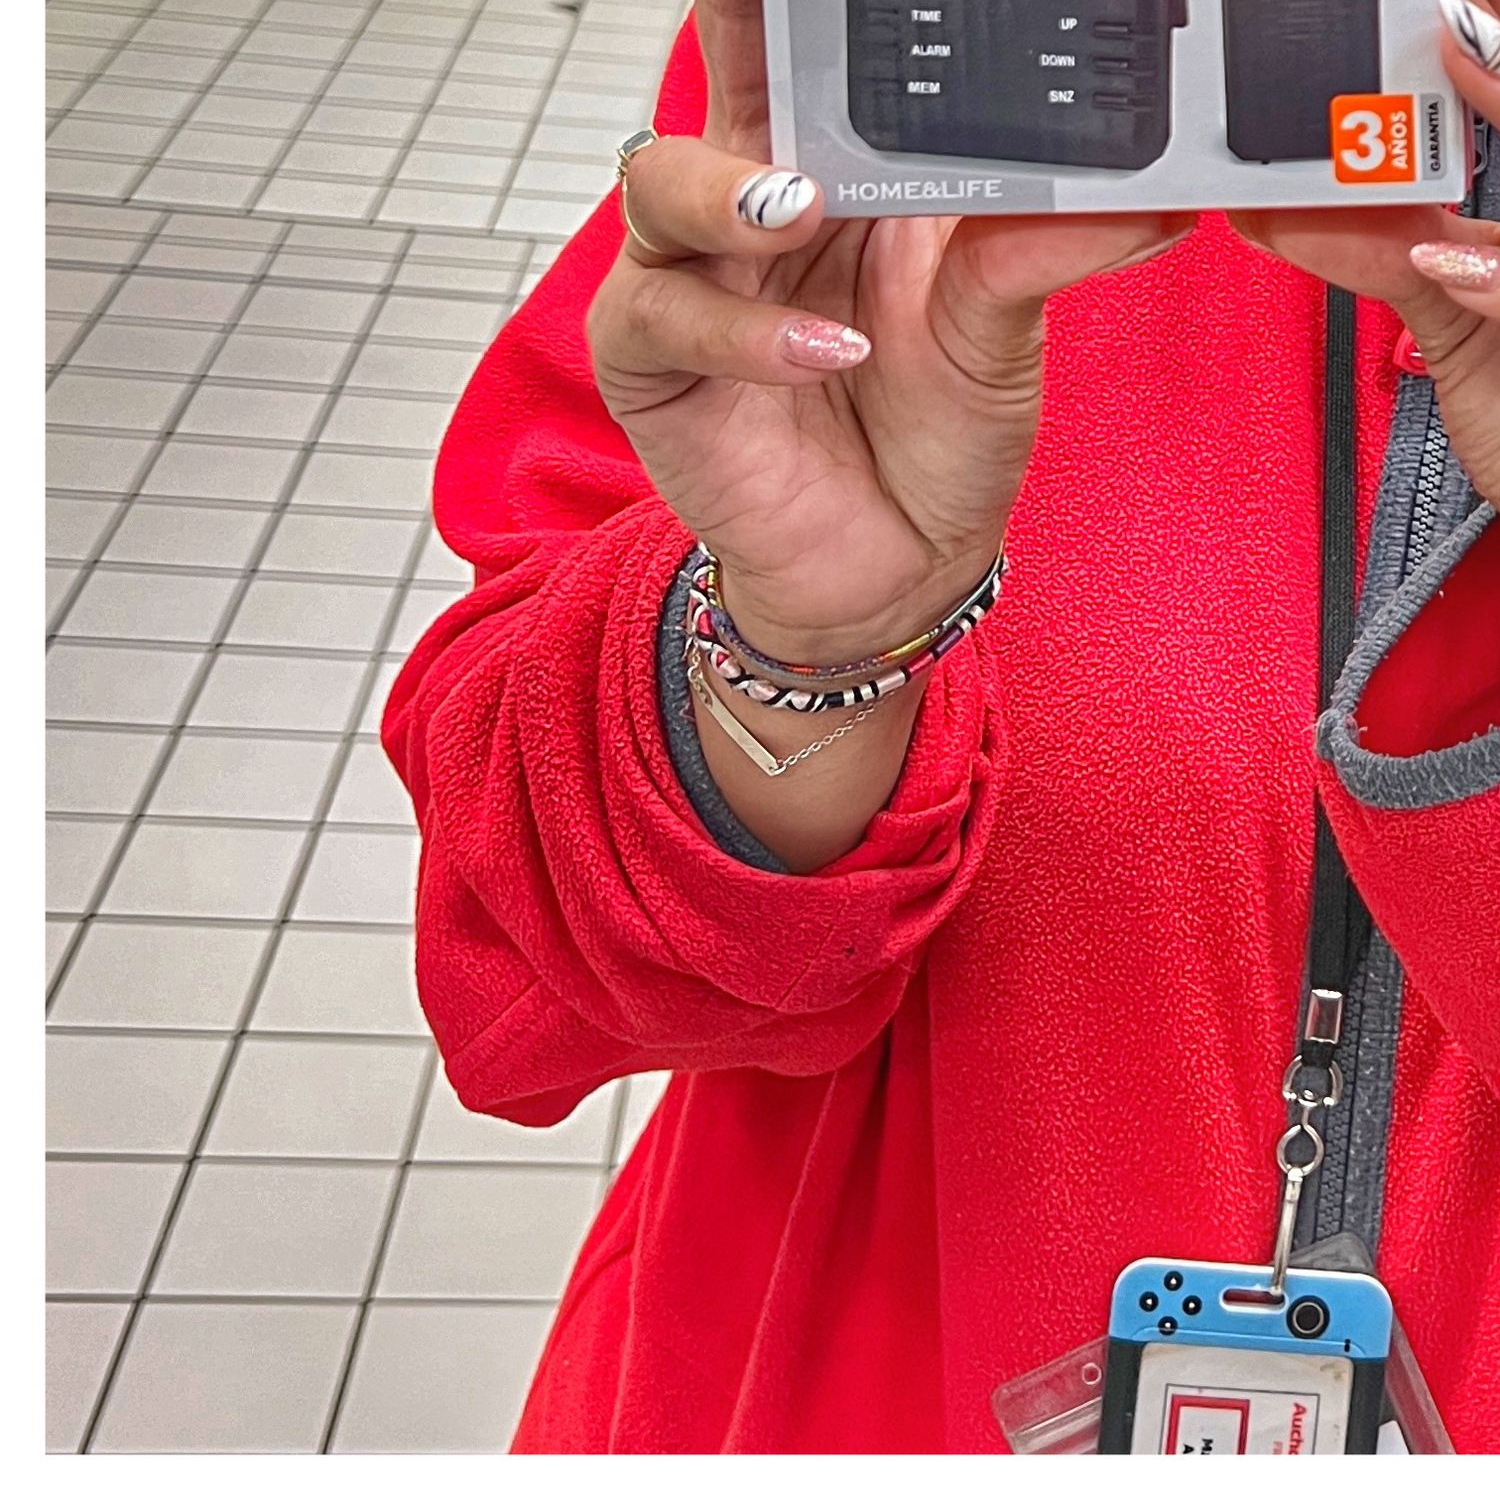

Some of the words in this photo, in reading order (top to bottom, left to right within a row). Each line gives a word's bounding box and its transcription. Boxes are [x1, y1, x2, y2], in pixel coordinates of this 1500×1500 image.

[911, 10, 942, 22] TIME
[1059, 17, 1078, 30] UP
[910, 44, 951, 57] ALARM
[1039, 54, 1075, 67] DOWN
[907, 82, 941, 94] MEM
[1048, 90, 1075, 103] SNZ
[1340, 109, 1387, 172] 3
[1387, 110, 1409, 170] AÑOS
[838, 179, 1003, 202] HOME&LIFE
